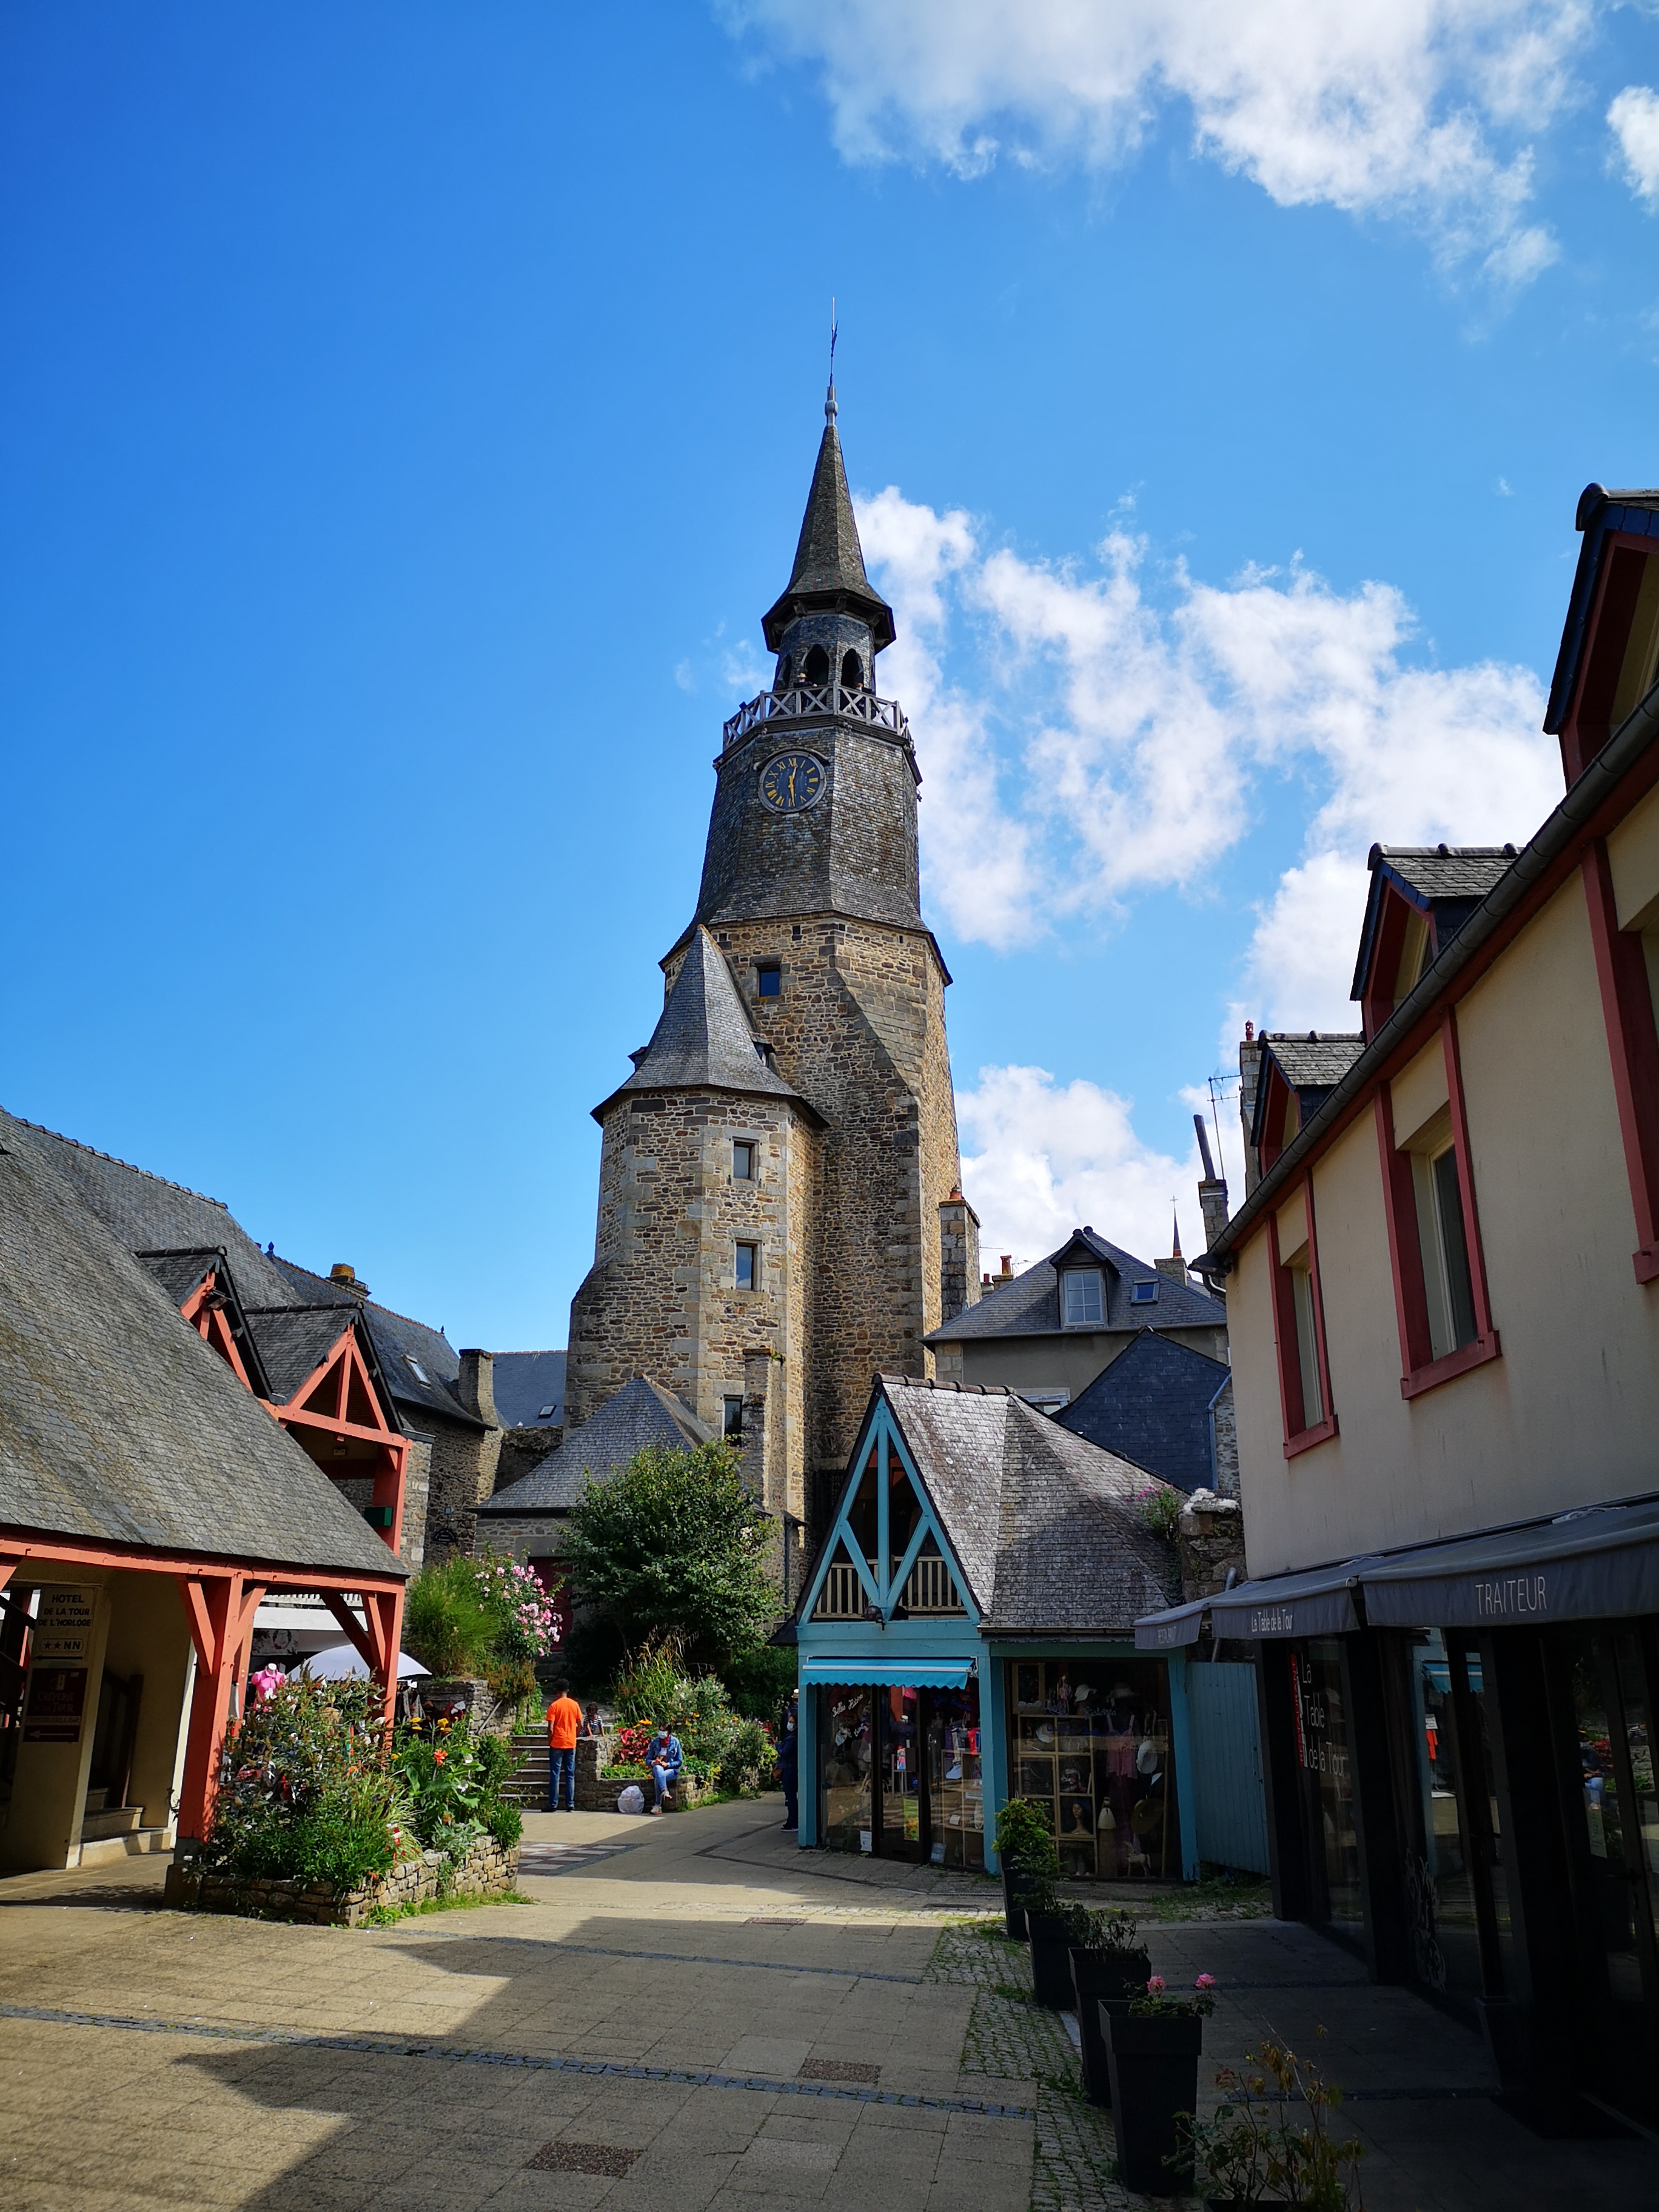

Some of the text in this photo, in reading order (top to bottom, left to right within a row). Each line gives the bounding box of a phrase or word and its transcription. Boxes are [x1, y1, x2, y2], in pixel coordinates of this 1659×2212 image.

[768, 770, 778, 779] X
[52, 1594, 84, 1603] HOTEL
[1475, 1575, 1547, 1615] TRAITEUR
[1252, 1607, 1293, 1632] La Table de la Tour
[1301, 1654, 1312, 1684] La
[1304, 1692, 1326, 1729] Table
[1309, 1734, 1346, 1777] de la Tour
